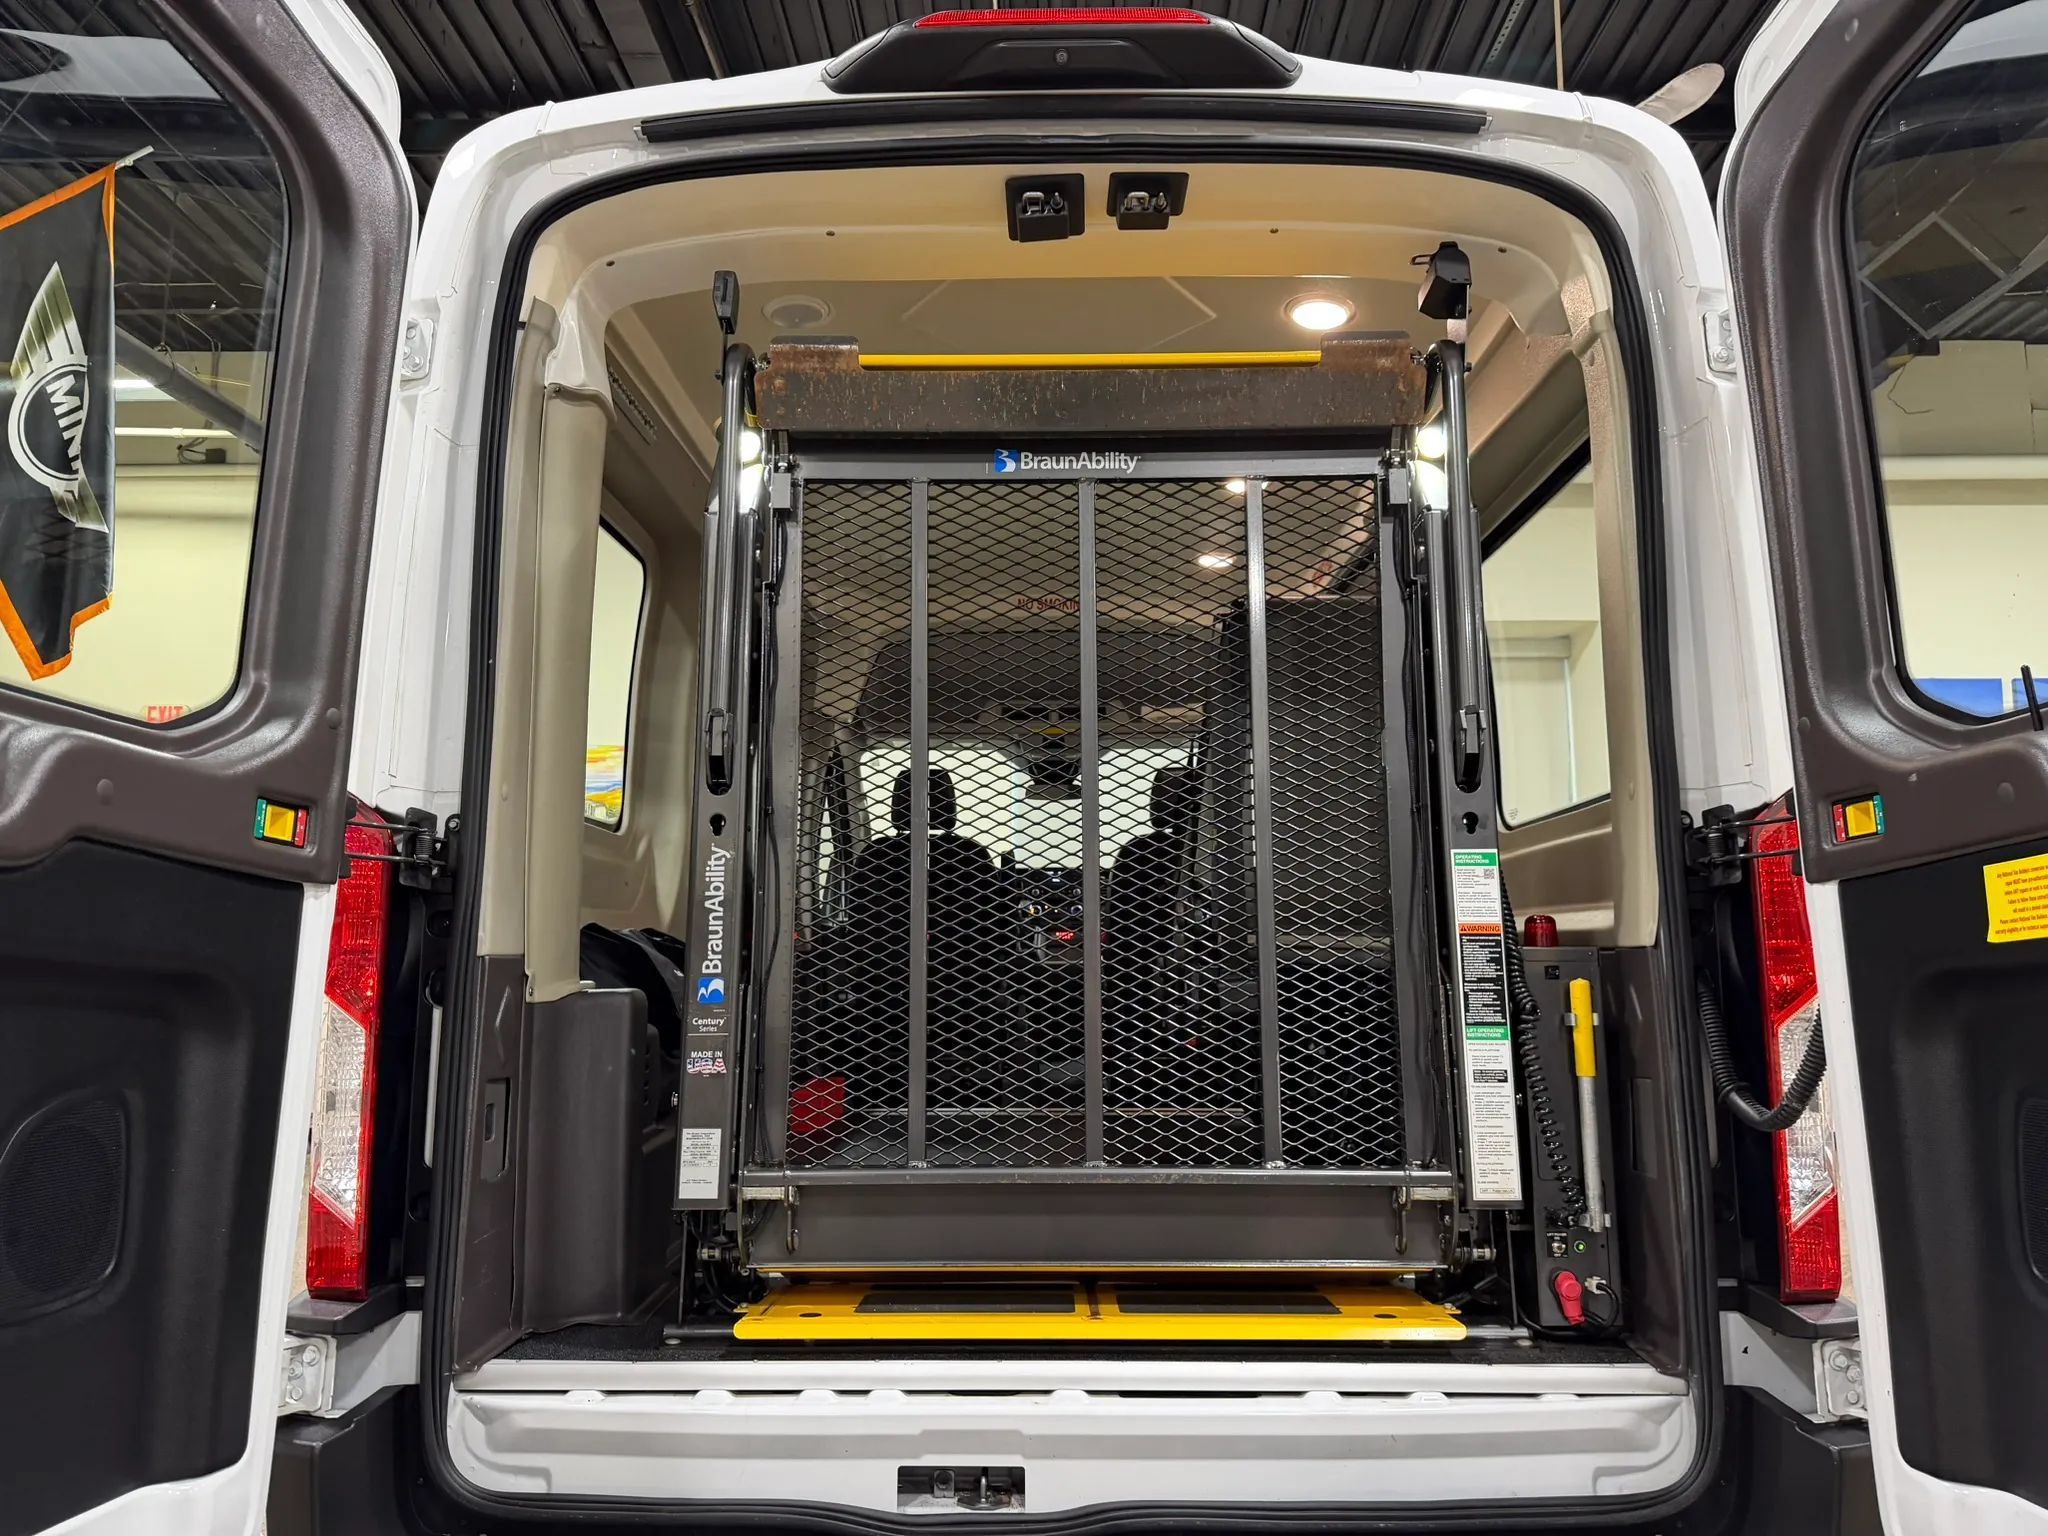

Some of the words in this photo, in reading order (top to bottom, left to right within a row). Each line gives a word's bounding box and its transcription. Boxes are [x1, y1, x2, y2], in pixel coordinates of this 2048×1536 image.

[46, 374, 83, 471] MIN
[1020, 451, 1138, 474] BraunAbility
[1036, 598, 1080, 610] SMOKIN
[701, 846, 731, 974] BraunAbility
[692, 1017, 726, 1026] Century
[714, 1050, 723, 1058] IN
[687, 1058, 727, 1074] USA
